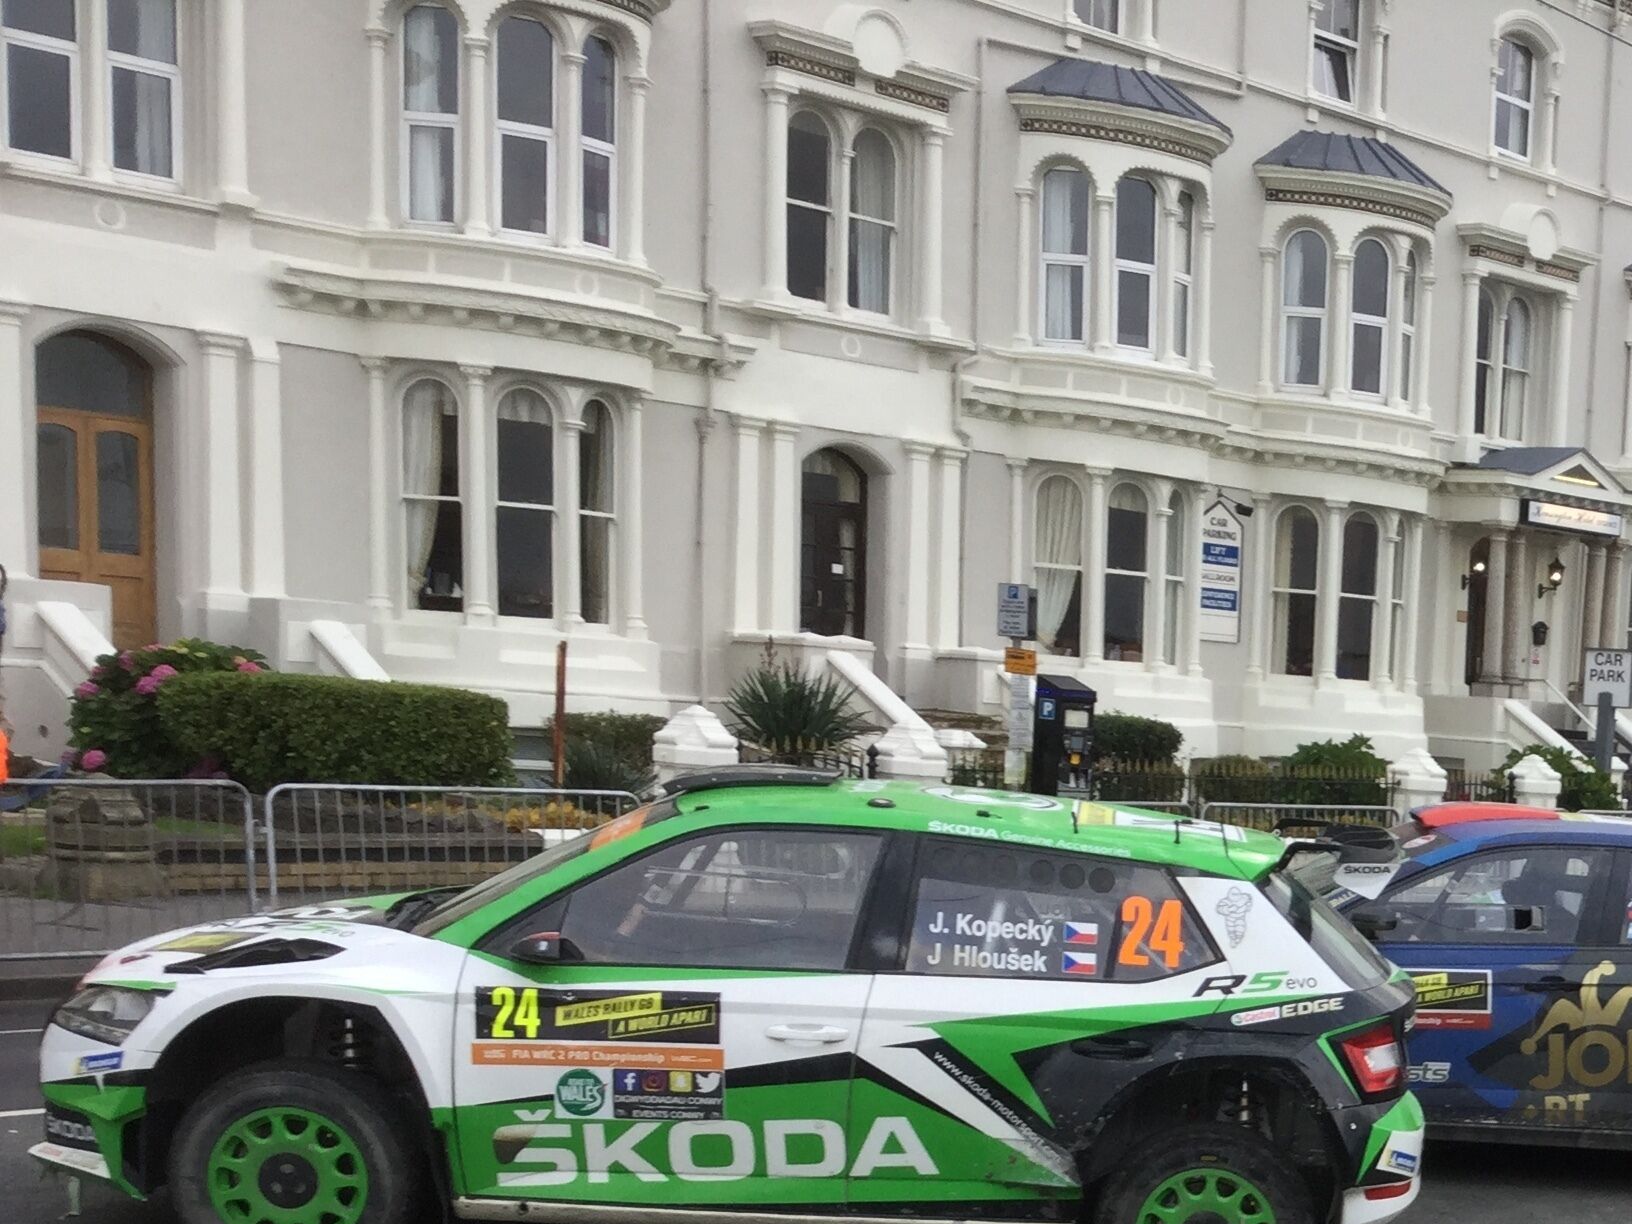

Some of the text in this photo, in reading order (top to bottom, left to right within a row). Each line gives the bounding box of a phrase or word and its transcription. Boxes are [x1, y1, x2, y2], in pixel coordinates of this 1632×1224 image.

[1594, 652, 1623, 667] CAR
[1589, 668, 1625, 683] PARK
[1042, 701, 1053, 716] P
[928, 820, 1132, 858] ŠKODA Genuine Accessories
[1343, 865, 1391, 874] ŠKODA
[928, 911, 1055, 947] J. Kopecký
[1117, 895, 1185, 968] 24
[927, 943, 1047, 973] J Hloušek
[1193, 970, 1318, 998] R5 evo
[490, 986, 542, 1039] 24
[562, 1004, 600, 1021] WALES
[602, 999, 635, 1015] RALLY
[1280, 997, 1345, 1019] EDGE
[614, 1008, 709, 1034] A WORLD APART
[511, 1049, 532, 1060] FIA
[591, 1050, 666, 1064] Championship
[631, 1109, 669, 1119] EVENTS
[492, 1109, 940, 1187] ŠKODA
